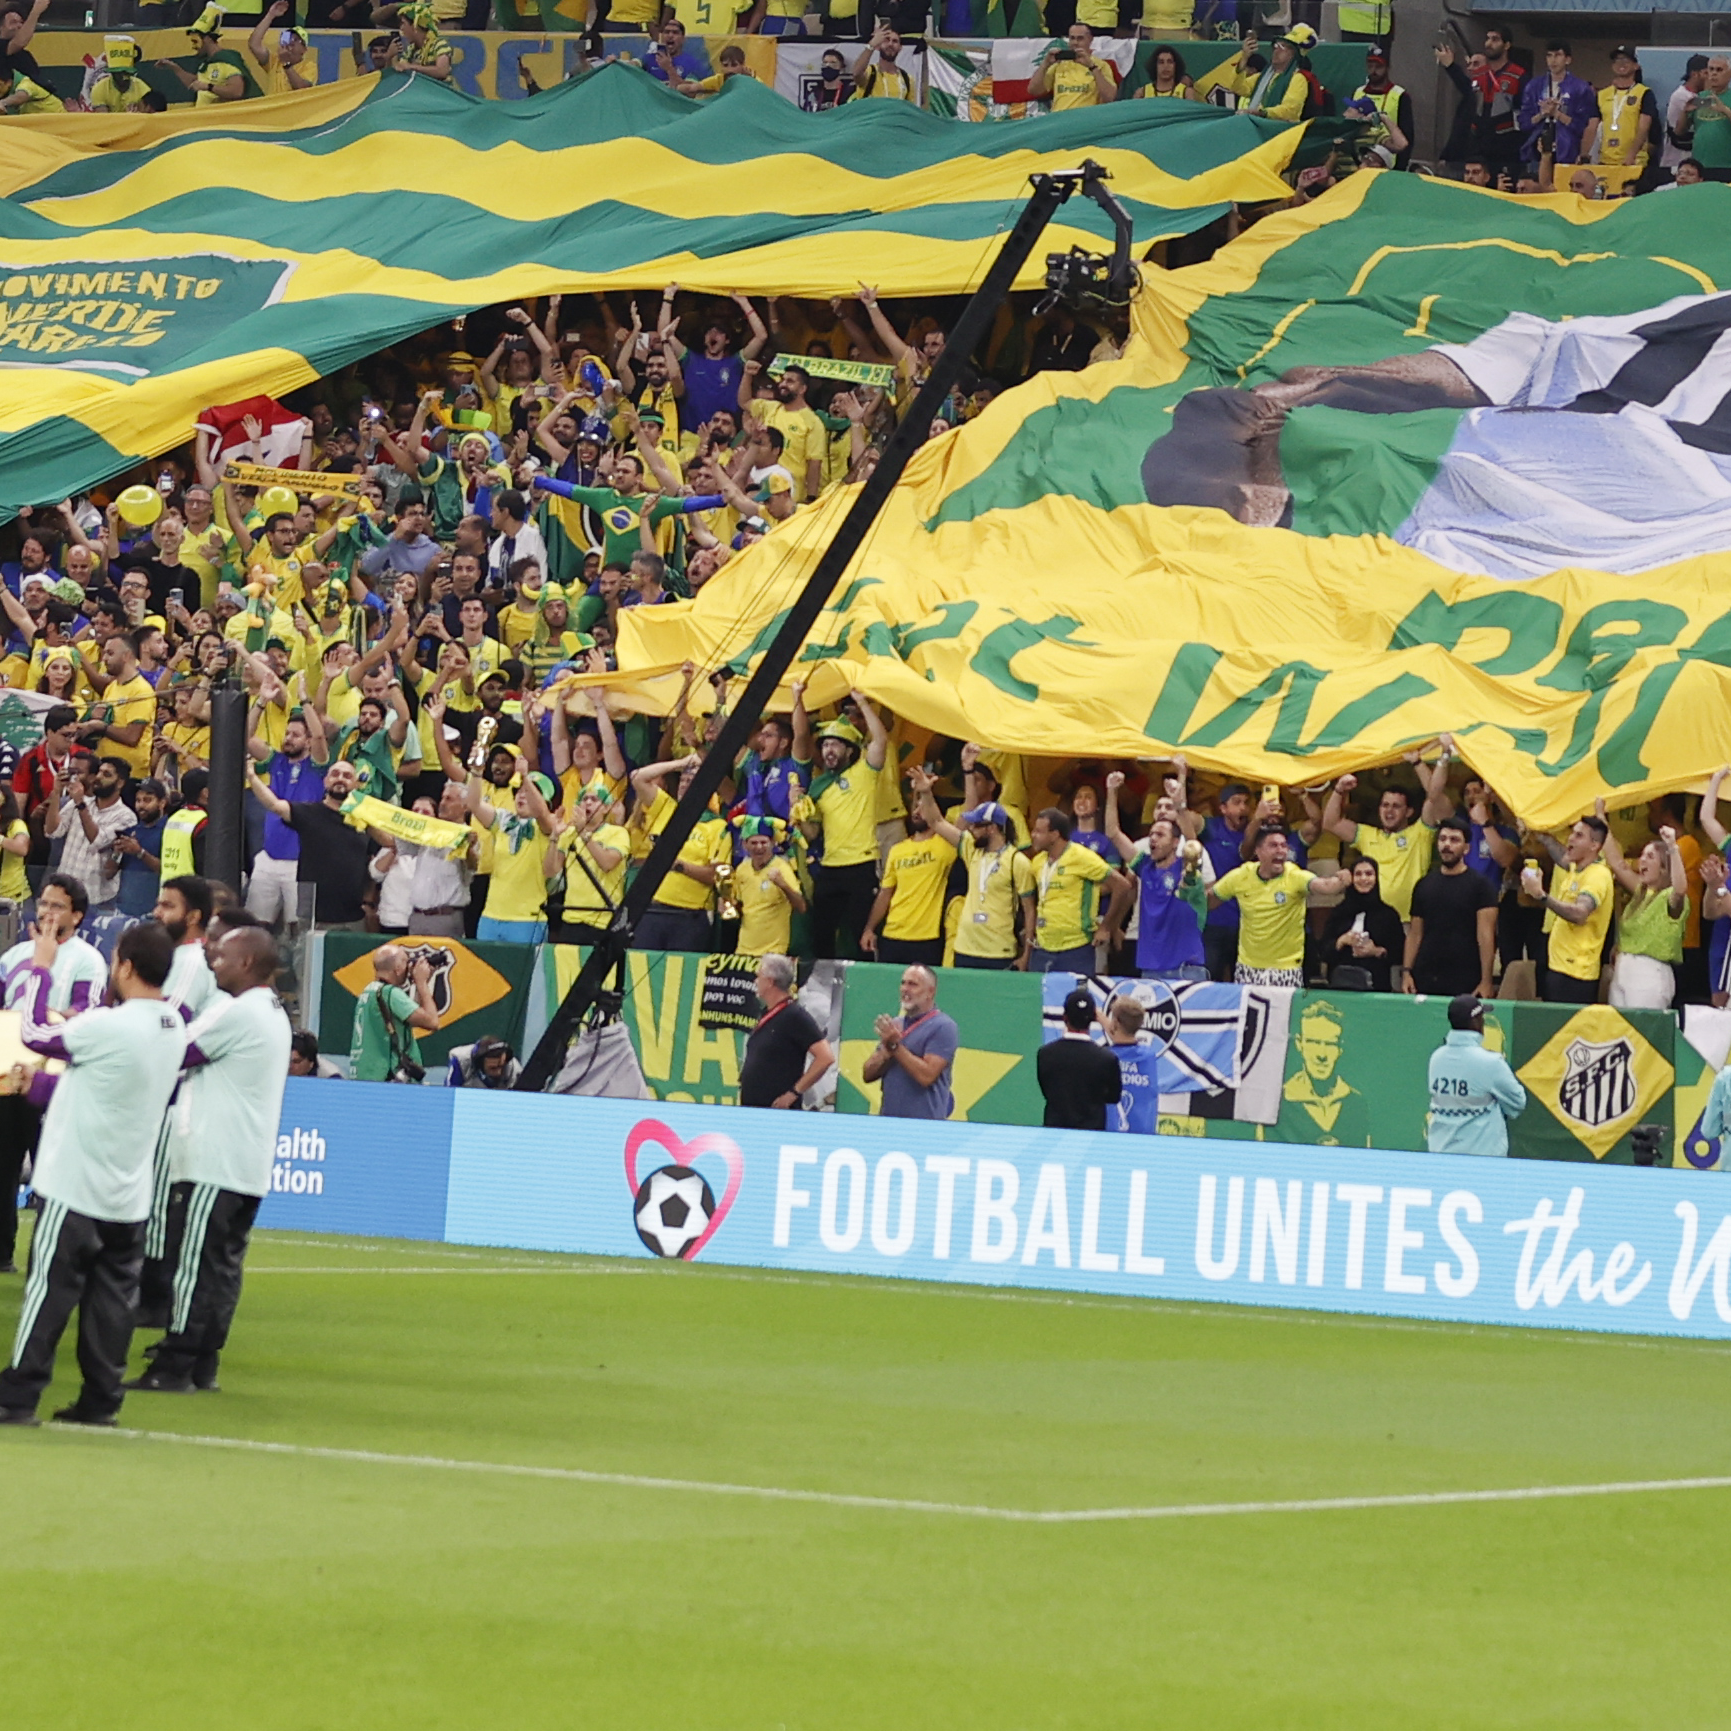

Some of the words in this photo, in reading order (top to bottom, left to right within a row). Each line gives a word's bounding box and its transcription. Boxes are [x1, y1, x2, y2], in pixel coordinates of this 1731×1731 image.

[810, 360, 867, 382] BRAZIL
[390, 811, 427, 832] Brazil
[1432, 1078, 1469, 1097] 4218
[773, 1144, 1166, 1276] FOOTBALL
[1194, 1174, 1484, 1298] UNITES
[1503, 1186, 1653, 1311] the
